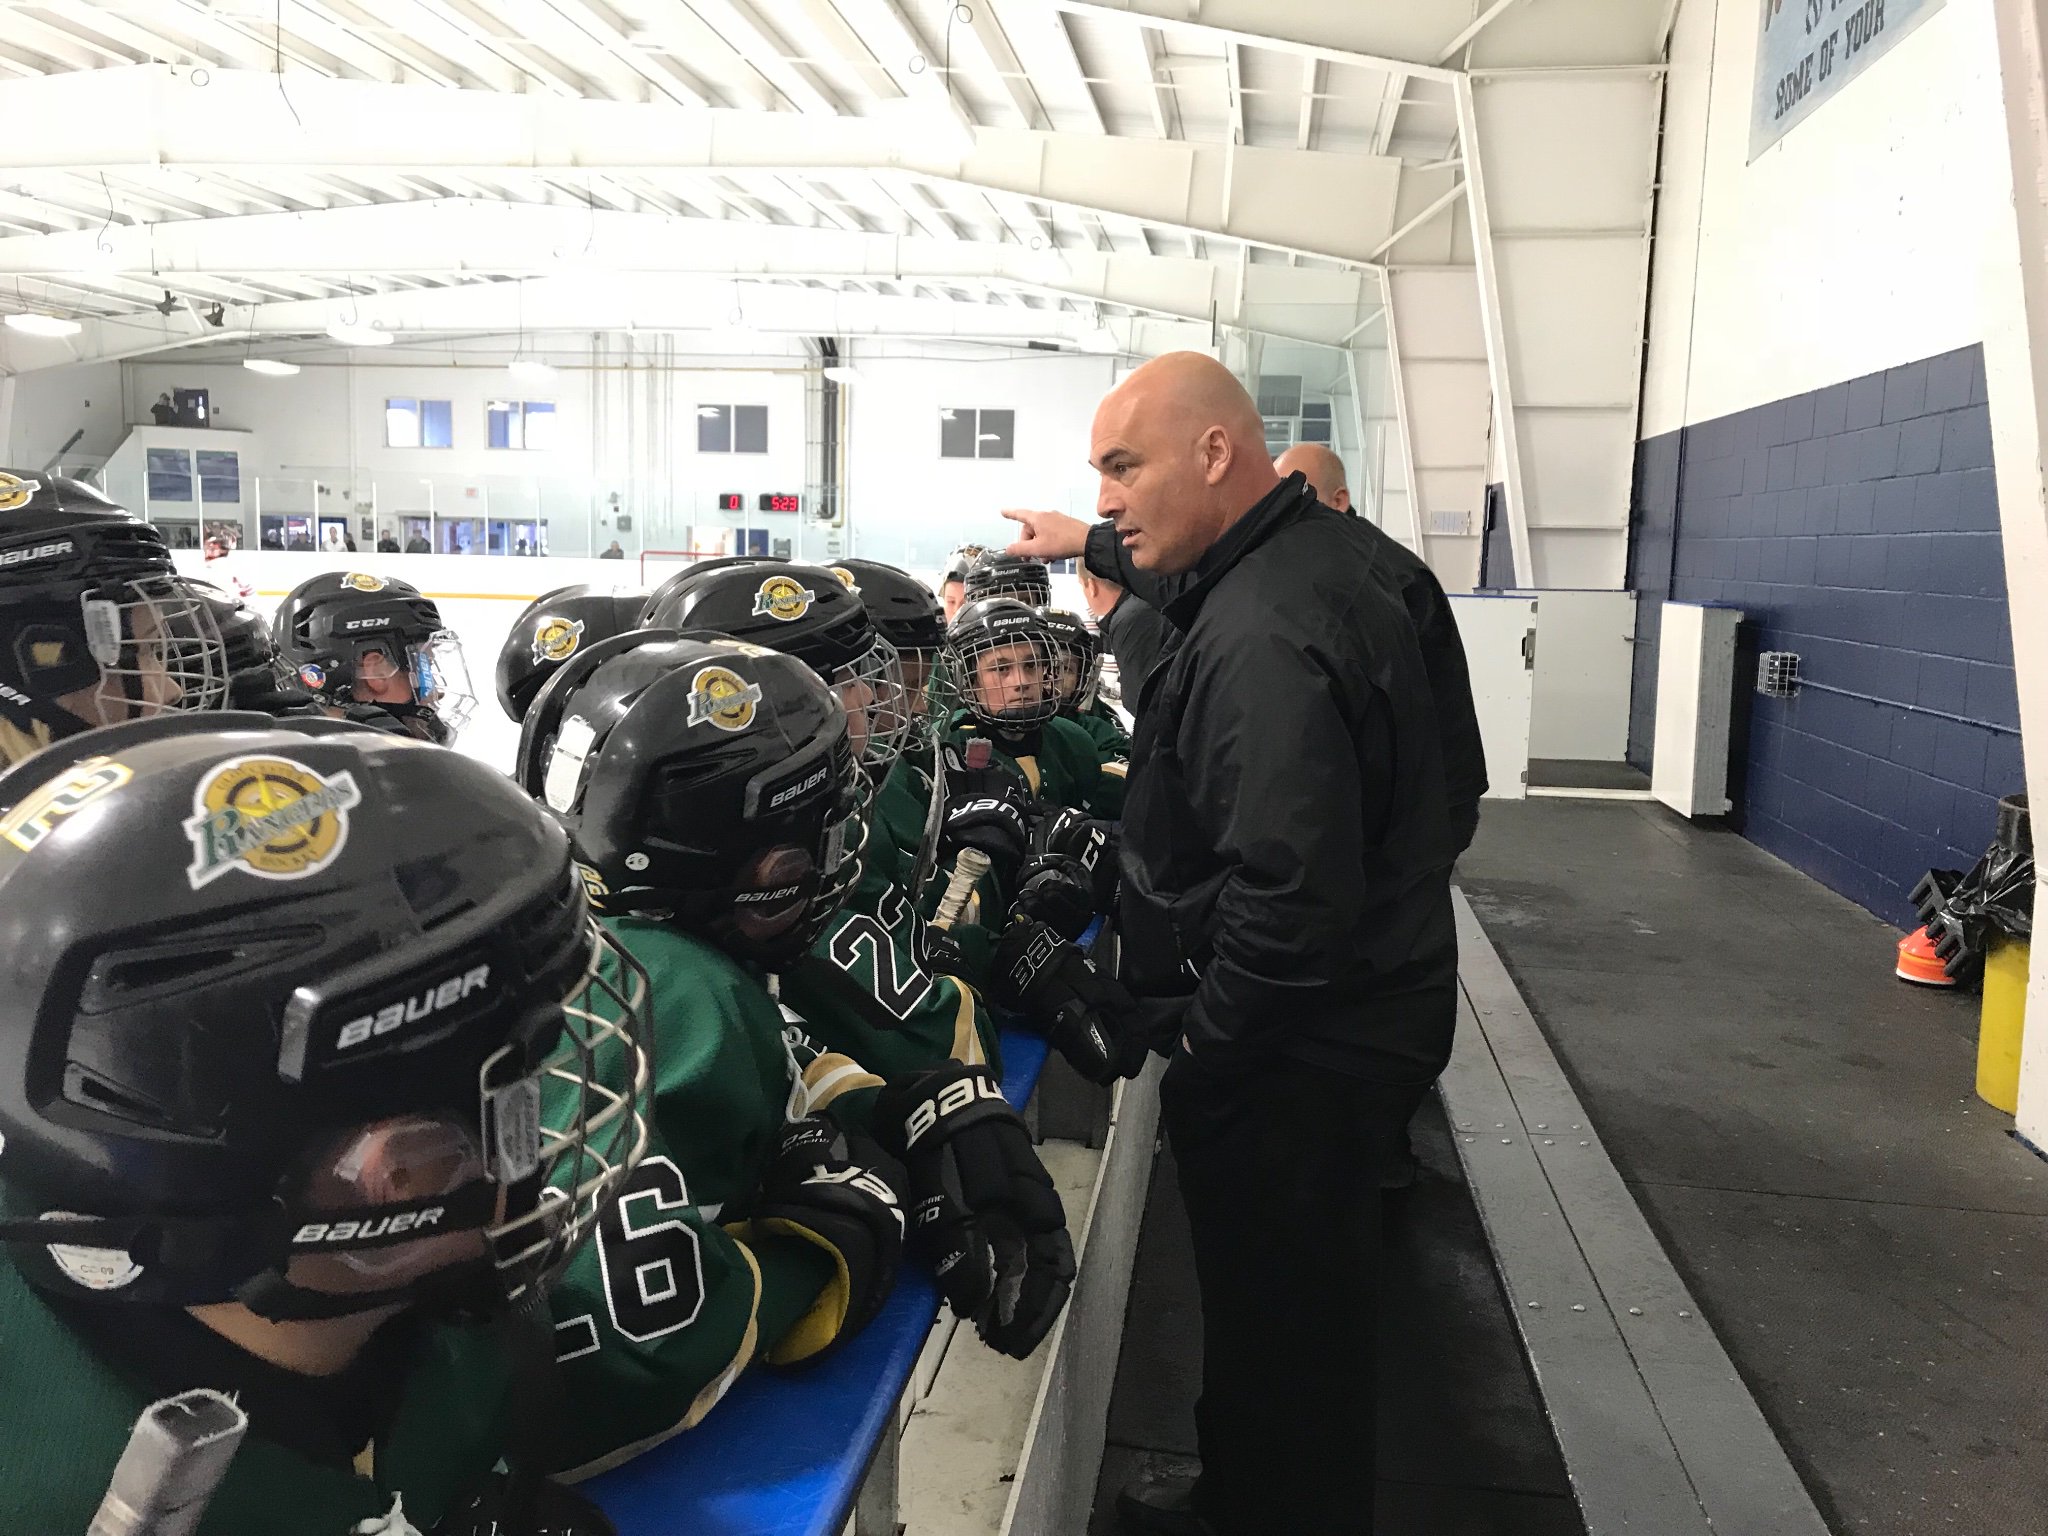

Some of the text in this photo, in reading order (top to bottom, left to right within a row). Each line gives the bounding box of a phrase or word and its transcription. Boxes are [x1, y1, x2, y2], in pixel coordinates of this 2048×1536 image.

[1775, 52, 1815, 120] HOME
[1819, 29, 1840, 82] OF
[1845, 0, 1885, 60] YOUR
[0, 541, 73, 566] AUER
[346, 617, 390, 630] CCM
[993, 616, 1030, 627] BAUER
[770, 767, 828, 808] BAUER
[734, 885, 799, 903] BAUER
[336, 963, 492, 1050] BAUER
[906, 1075, 1009, 1151] BAU
[293, 1206, 445, 1243] BAUER
